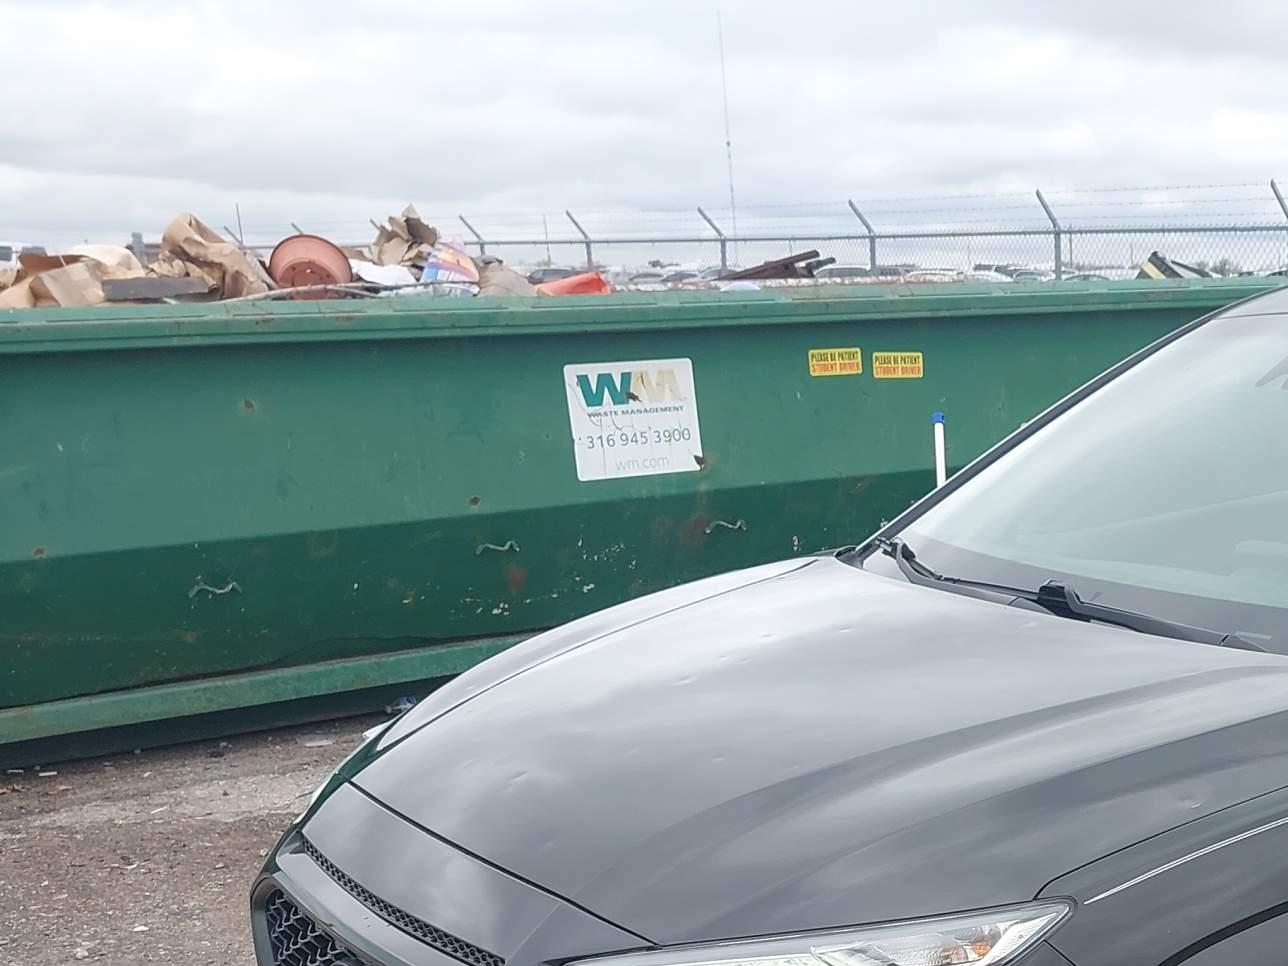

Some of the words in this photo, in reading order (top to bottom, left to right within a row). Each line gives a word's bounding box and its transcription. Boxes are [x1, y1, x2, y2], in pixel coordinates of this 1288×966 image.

[810, 352, 829, 363] PLEASE
[830, 352, 837, 362] BE
[838, 351, 859, 361] PATIENT
[874, 355, 893, 365] PLEASE
[893, 355, 899, 365] BE
[900, 355, 920, 365] PATIENT
[811, 363, 837, 373] STUDENT
[839, 362, 860, 372] DRIVER
[875, 366, 899, 376] STUDENT
[901, 366, 921, 376] DRIVER
[587, 410, 618, 418] WASTE
[621, 405, 684, 415] MANAGEMENT
[587, 434, 616, 449] 316
[620, 431, 648, 446] 945
[653, 428, 691, 443] 3900
[615, 456, 670, 471] wm.com
